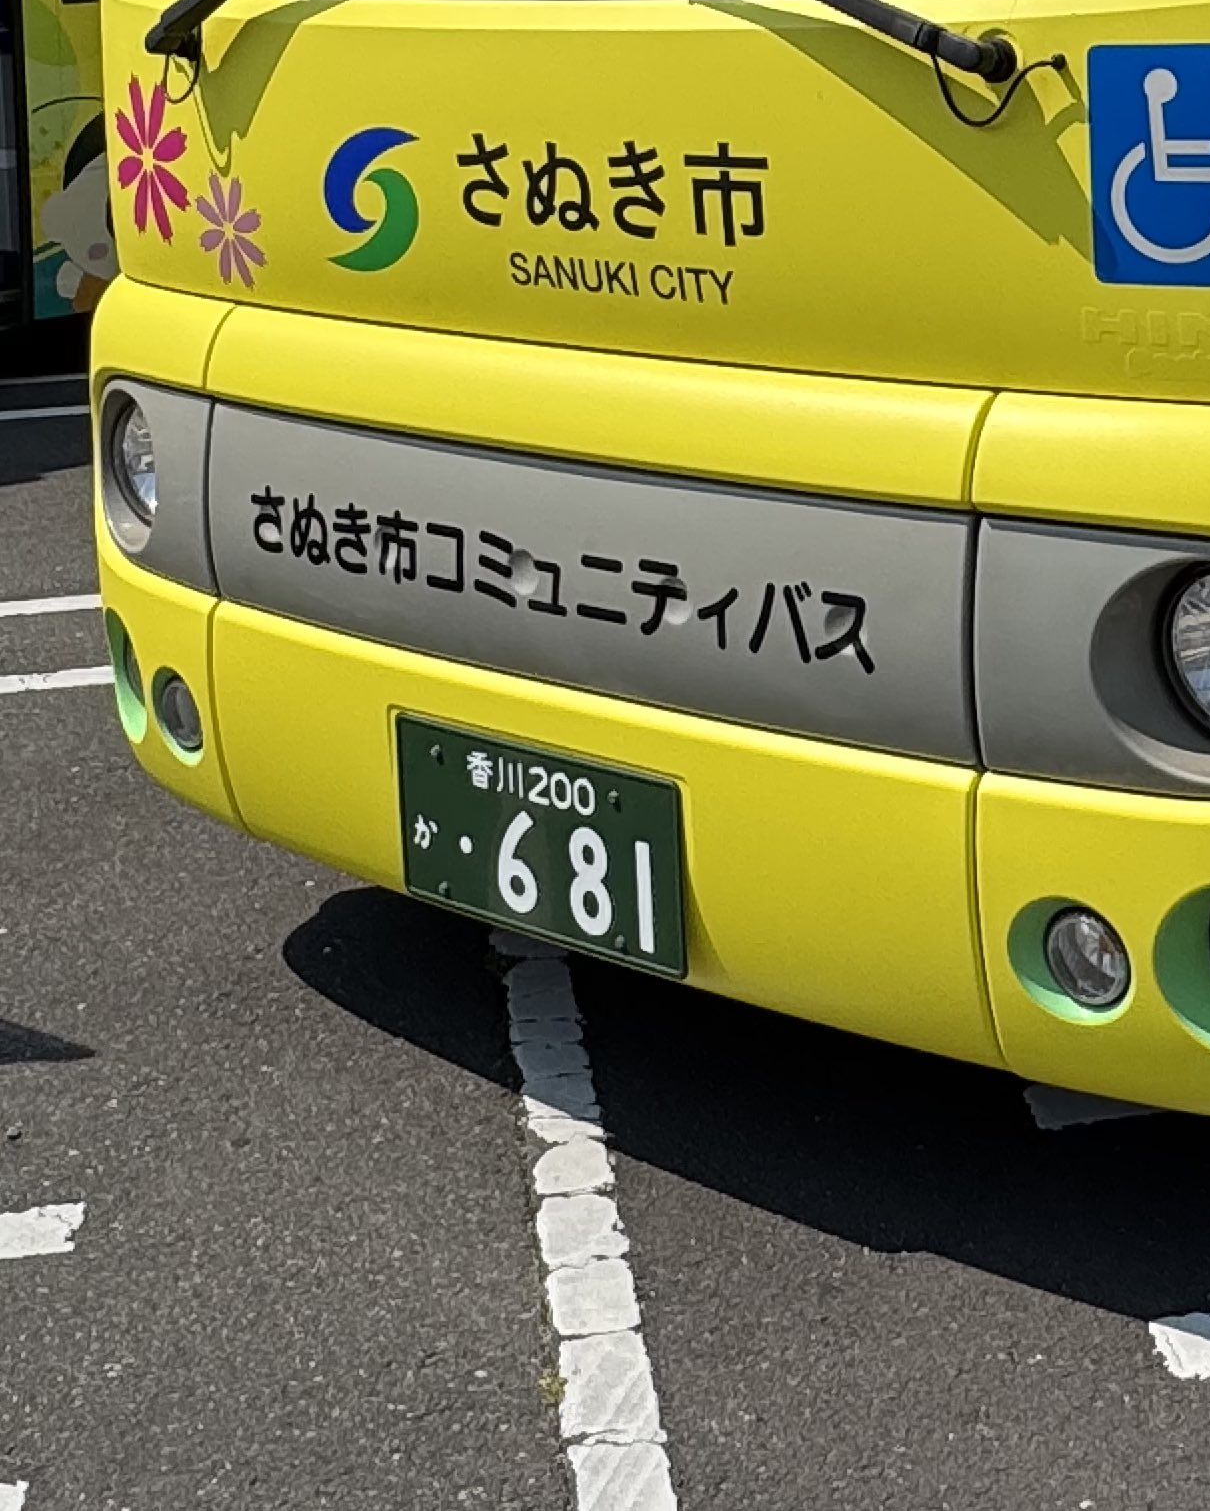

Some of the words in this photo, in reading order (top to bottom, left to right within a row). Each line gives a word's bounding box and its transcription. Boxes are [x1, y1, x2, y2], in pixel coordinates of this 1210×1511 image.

[456, 132, 769, 247] さぬき市
[509, 251, 640, 298] SANUKI
[649, 263, 734, 306] CITY
[249, 485, 876, 676] さぬき市コミュニティバス
[413, 814, 438, 850] か
